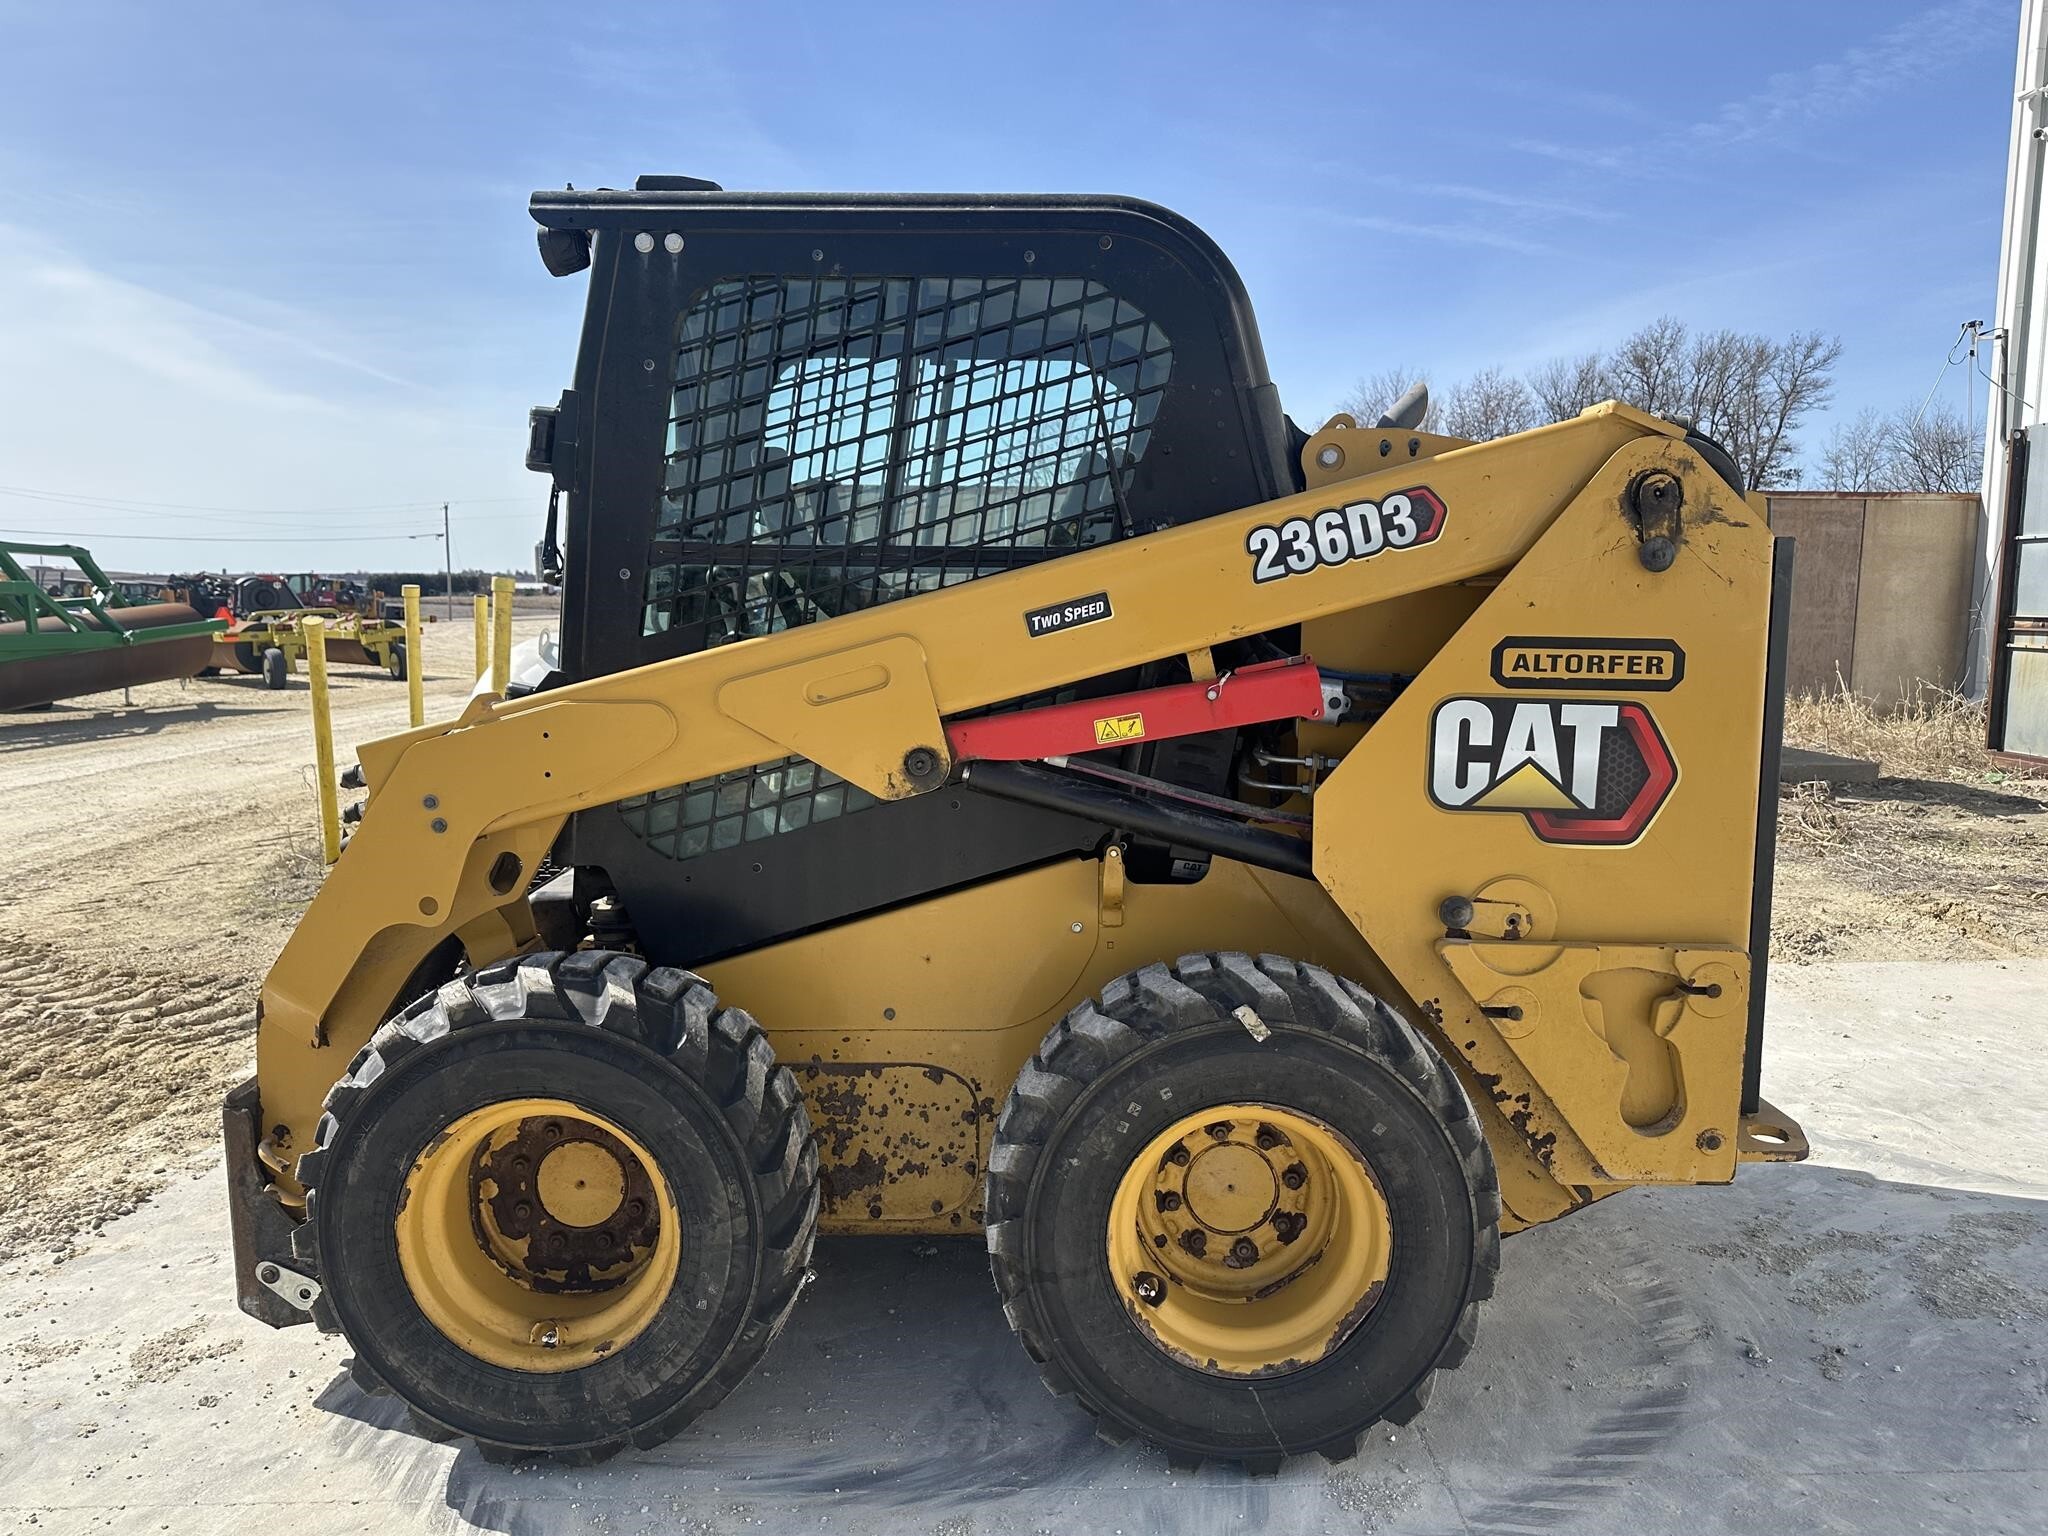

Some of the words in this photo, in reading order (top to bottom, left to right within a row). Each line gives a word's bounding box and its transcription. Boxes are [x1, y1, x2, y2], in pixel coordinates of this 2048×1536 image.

[1249, 494, 1418, 580] 236D3
[1511, 653, 1665, 675] ALTORFER
[1433, 699, 1619, 810] CAT
[1183, 862, 1202, 872] CAT
